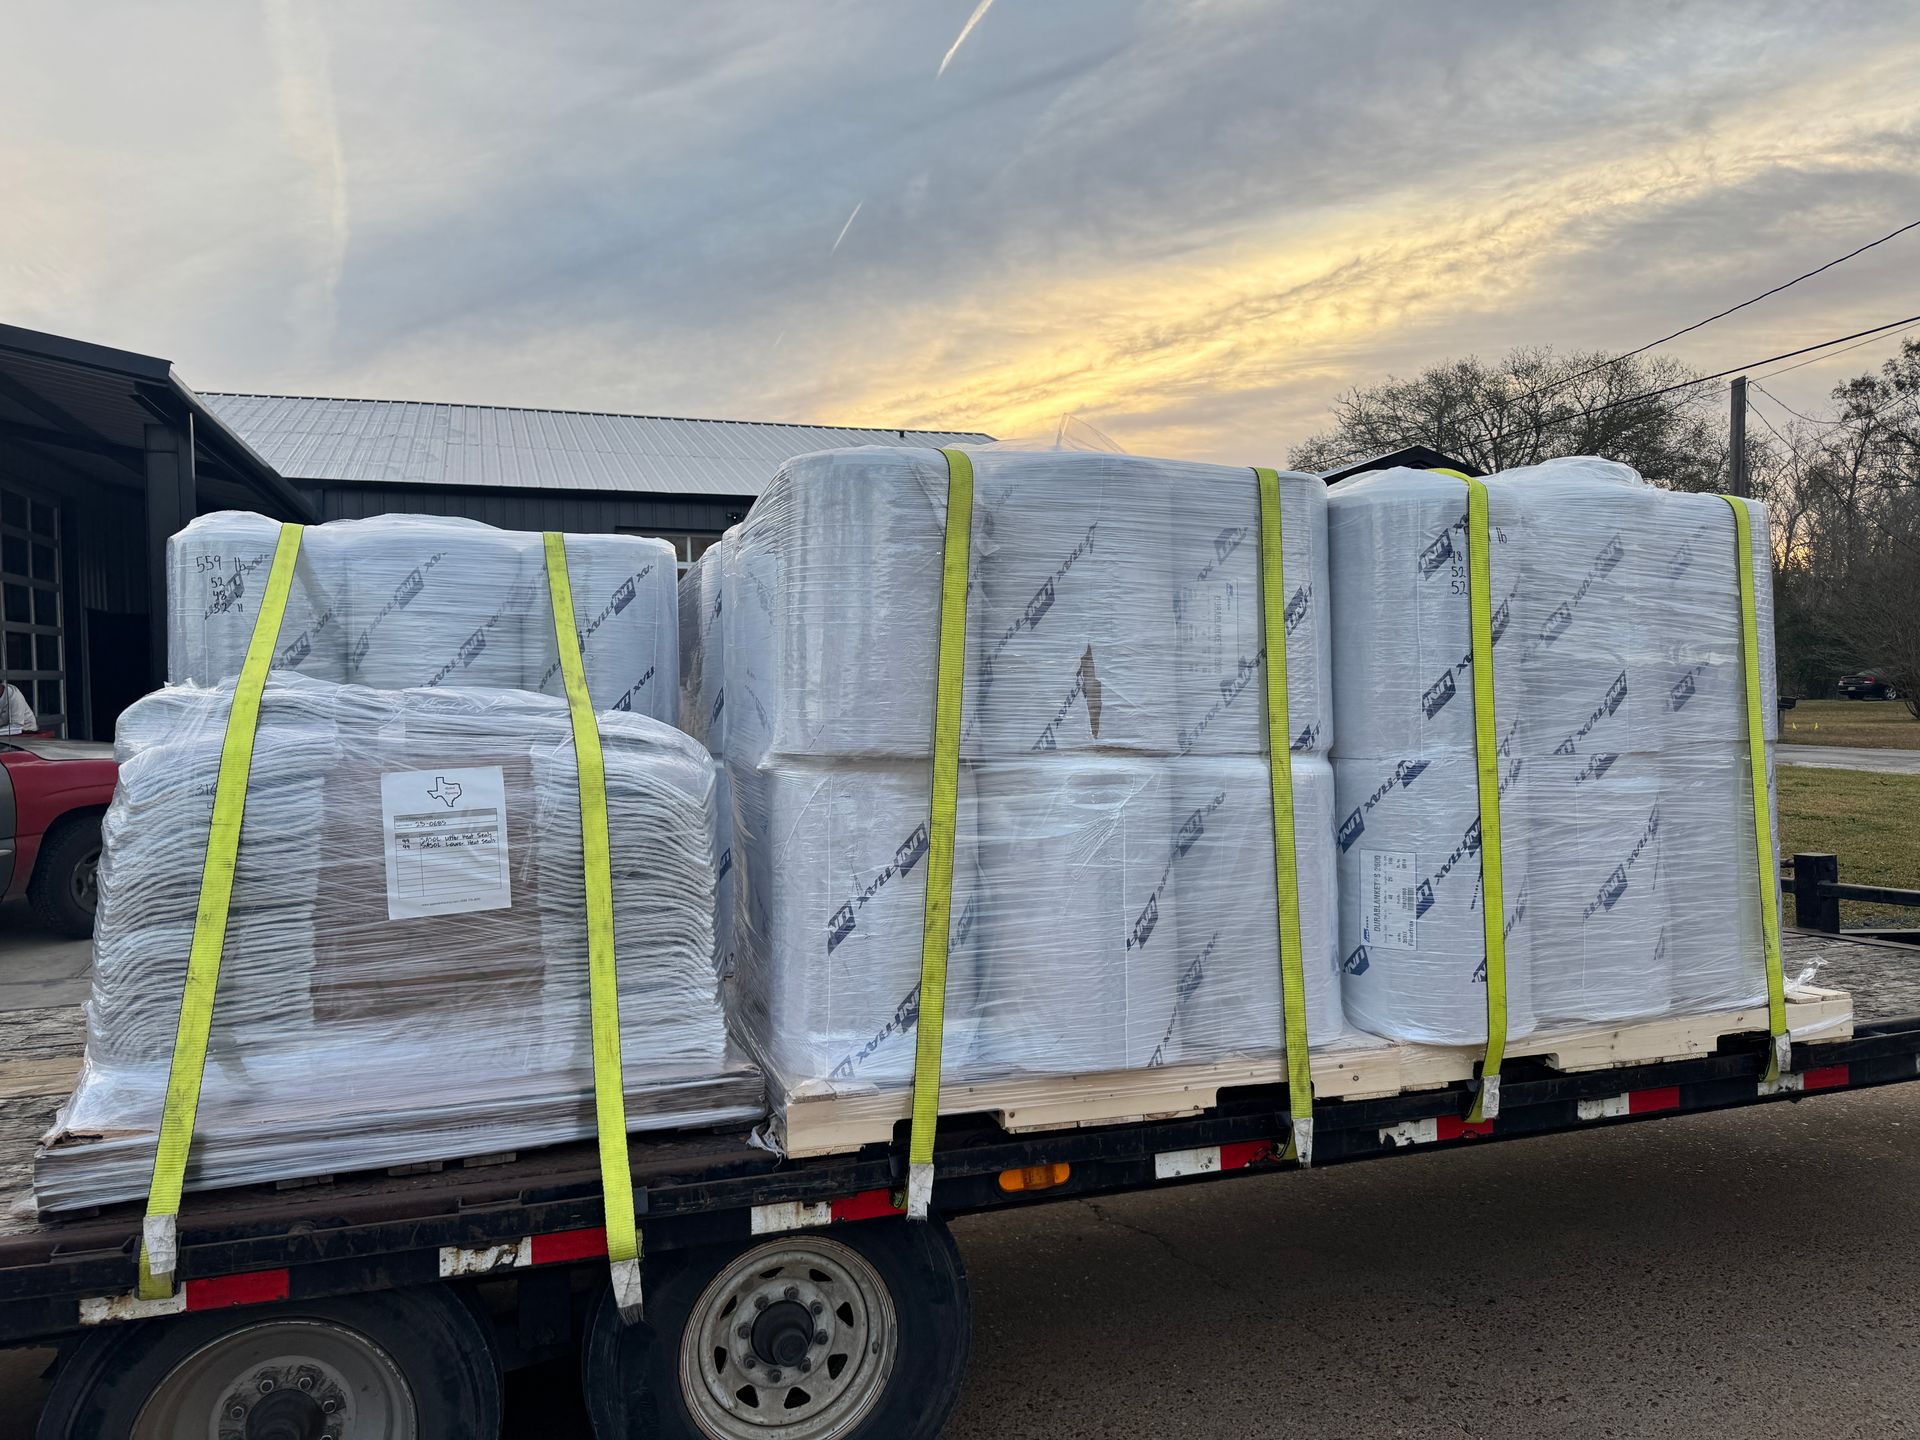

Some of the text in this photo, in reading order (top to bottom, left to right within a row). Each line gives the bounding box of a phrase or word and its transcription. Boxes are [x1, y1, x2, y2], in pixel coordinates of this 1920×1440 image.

[196, 554, 222, 573] 559
[210, 577, 225, 588] 52
[1451, 566, 1466, 578] 52
[1451, 580, 1469, 595] 52
[586, 576, 636, 638] UNIFRAX
[1577, 670, 1627, 741] UNIFRAX
[1364, 760, 1424, 813] NIFRAX
[857, 822, 930, 910] UNIFRAX
[1583, 864, 1629, 920] UNIFR
